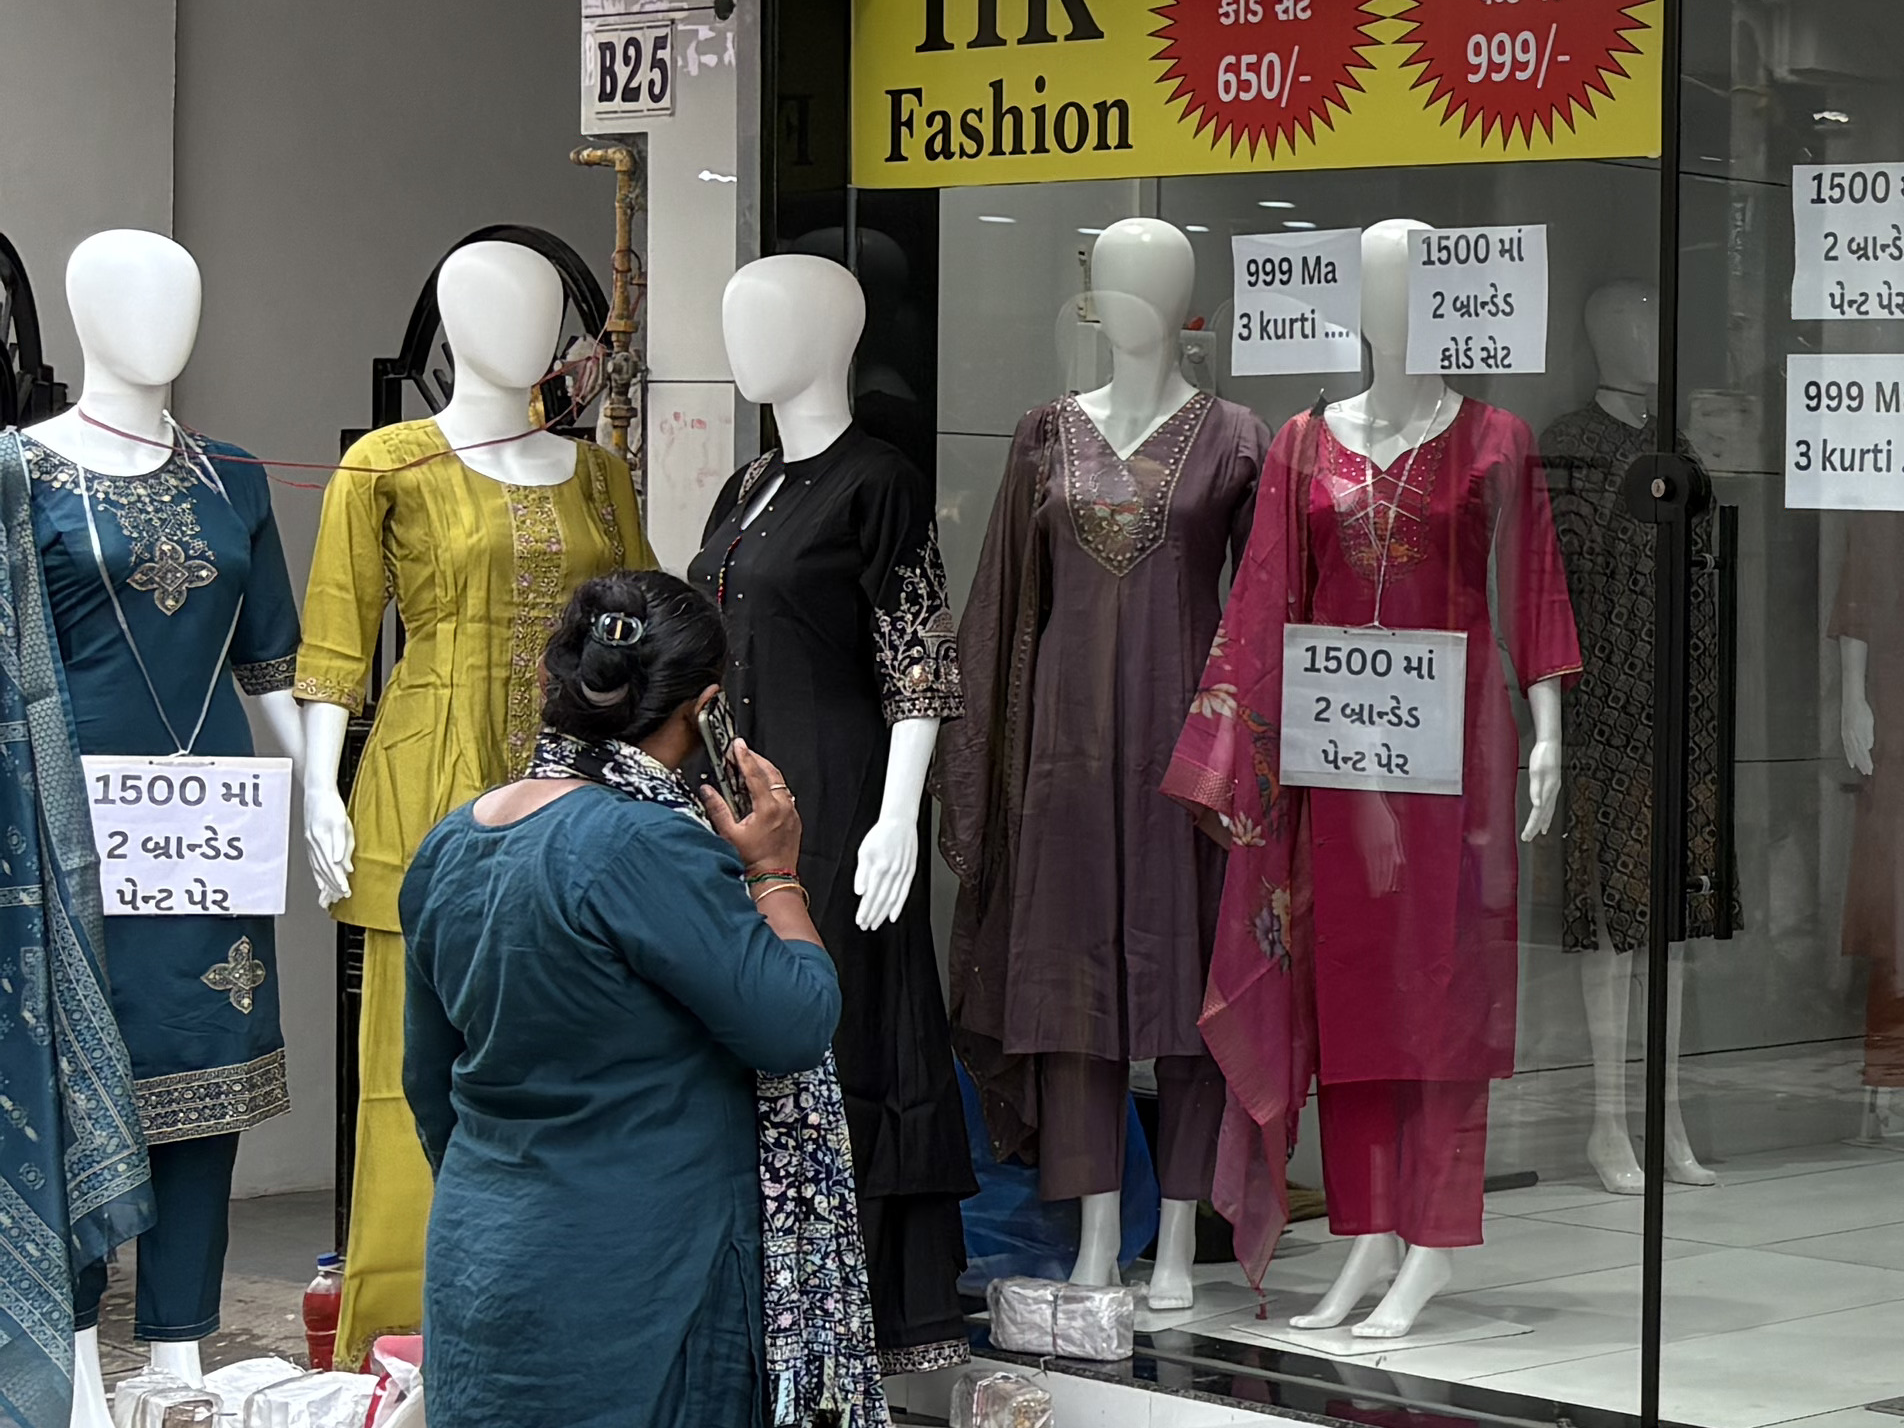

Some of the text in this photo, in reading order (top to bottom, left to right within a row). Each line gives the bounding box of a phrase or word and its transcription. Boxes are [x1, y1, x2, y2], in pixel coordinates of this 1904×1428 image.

[598, 32, 669, 103] B25
[1467, 23, 1571, 89] 999/-
[1217, 45, 1312, 108] 650/-
[884, 75, 1133, 162] Fashion
[1810, 170, 1890, 204] 1500
[1421, 228, 1524, 266] 1500 માં
[1823, 231, 1839, 261] 2
[1246, 255, 1338, 288] 999 Ma
[1432, 291, 1445, 319] 2
[1829, 280, 1870, 316] પેન્ટ
[1238, 312, 1252, 341] 3
[1258, 309, 1316, 341] kurti
[1480, 335, 1512, 369] સેટ
[1804, 380, 1864, 412] 999
[1794, 439, 1812, 471] 3
[1821, 438, 1892, 473] kurti
[1303, 645, 1435, 680] 1500 માં
[1314, 696, 1331, 722] 2
[1321, 739, 1410, 775] પેન્ટ પેર
[93, 773, 263, 808] 1500 માં
[106, 830, 129, 860] 2
[116, 877, 231, 911] પેન્ટ પેર
